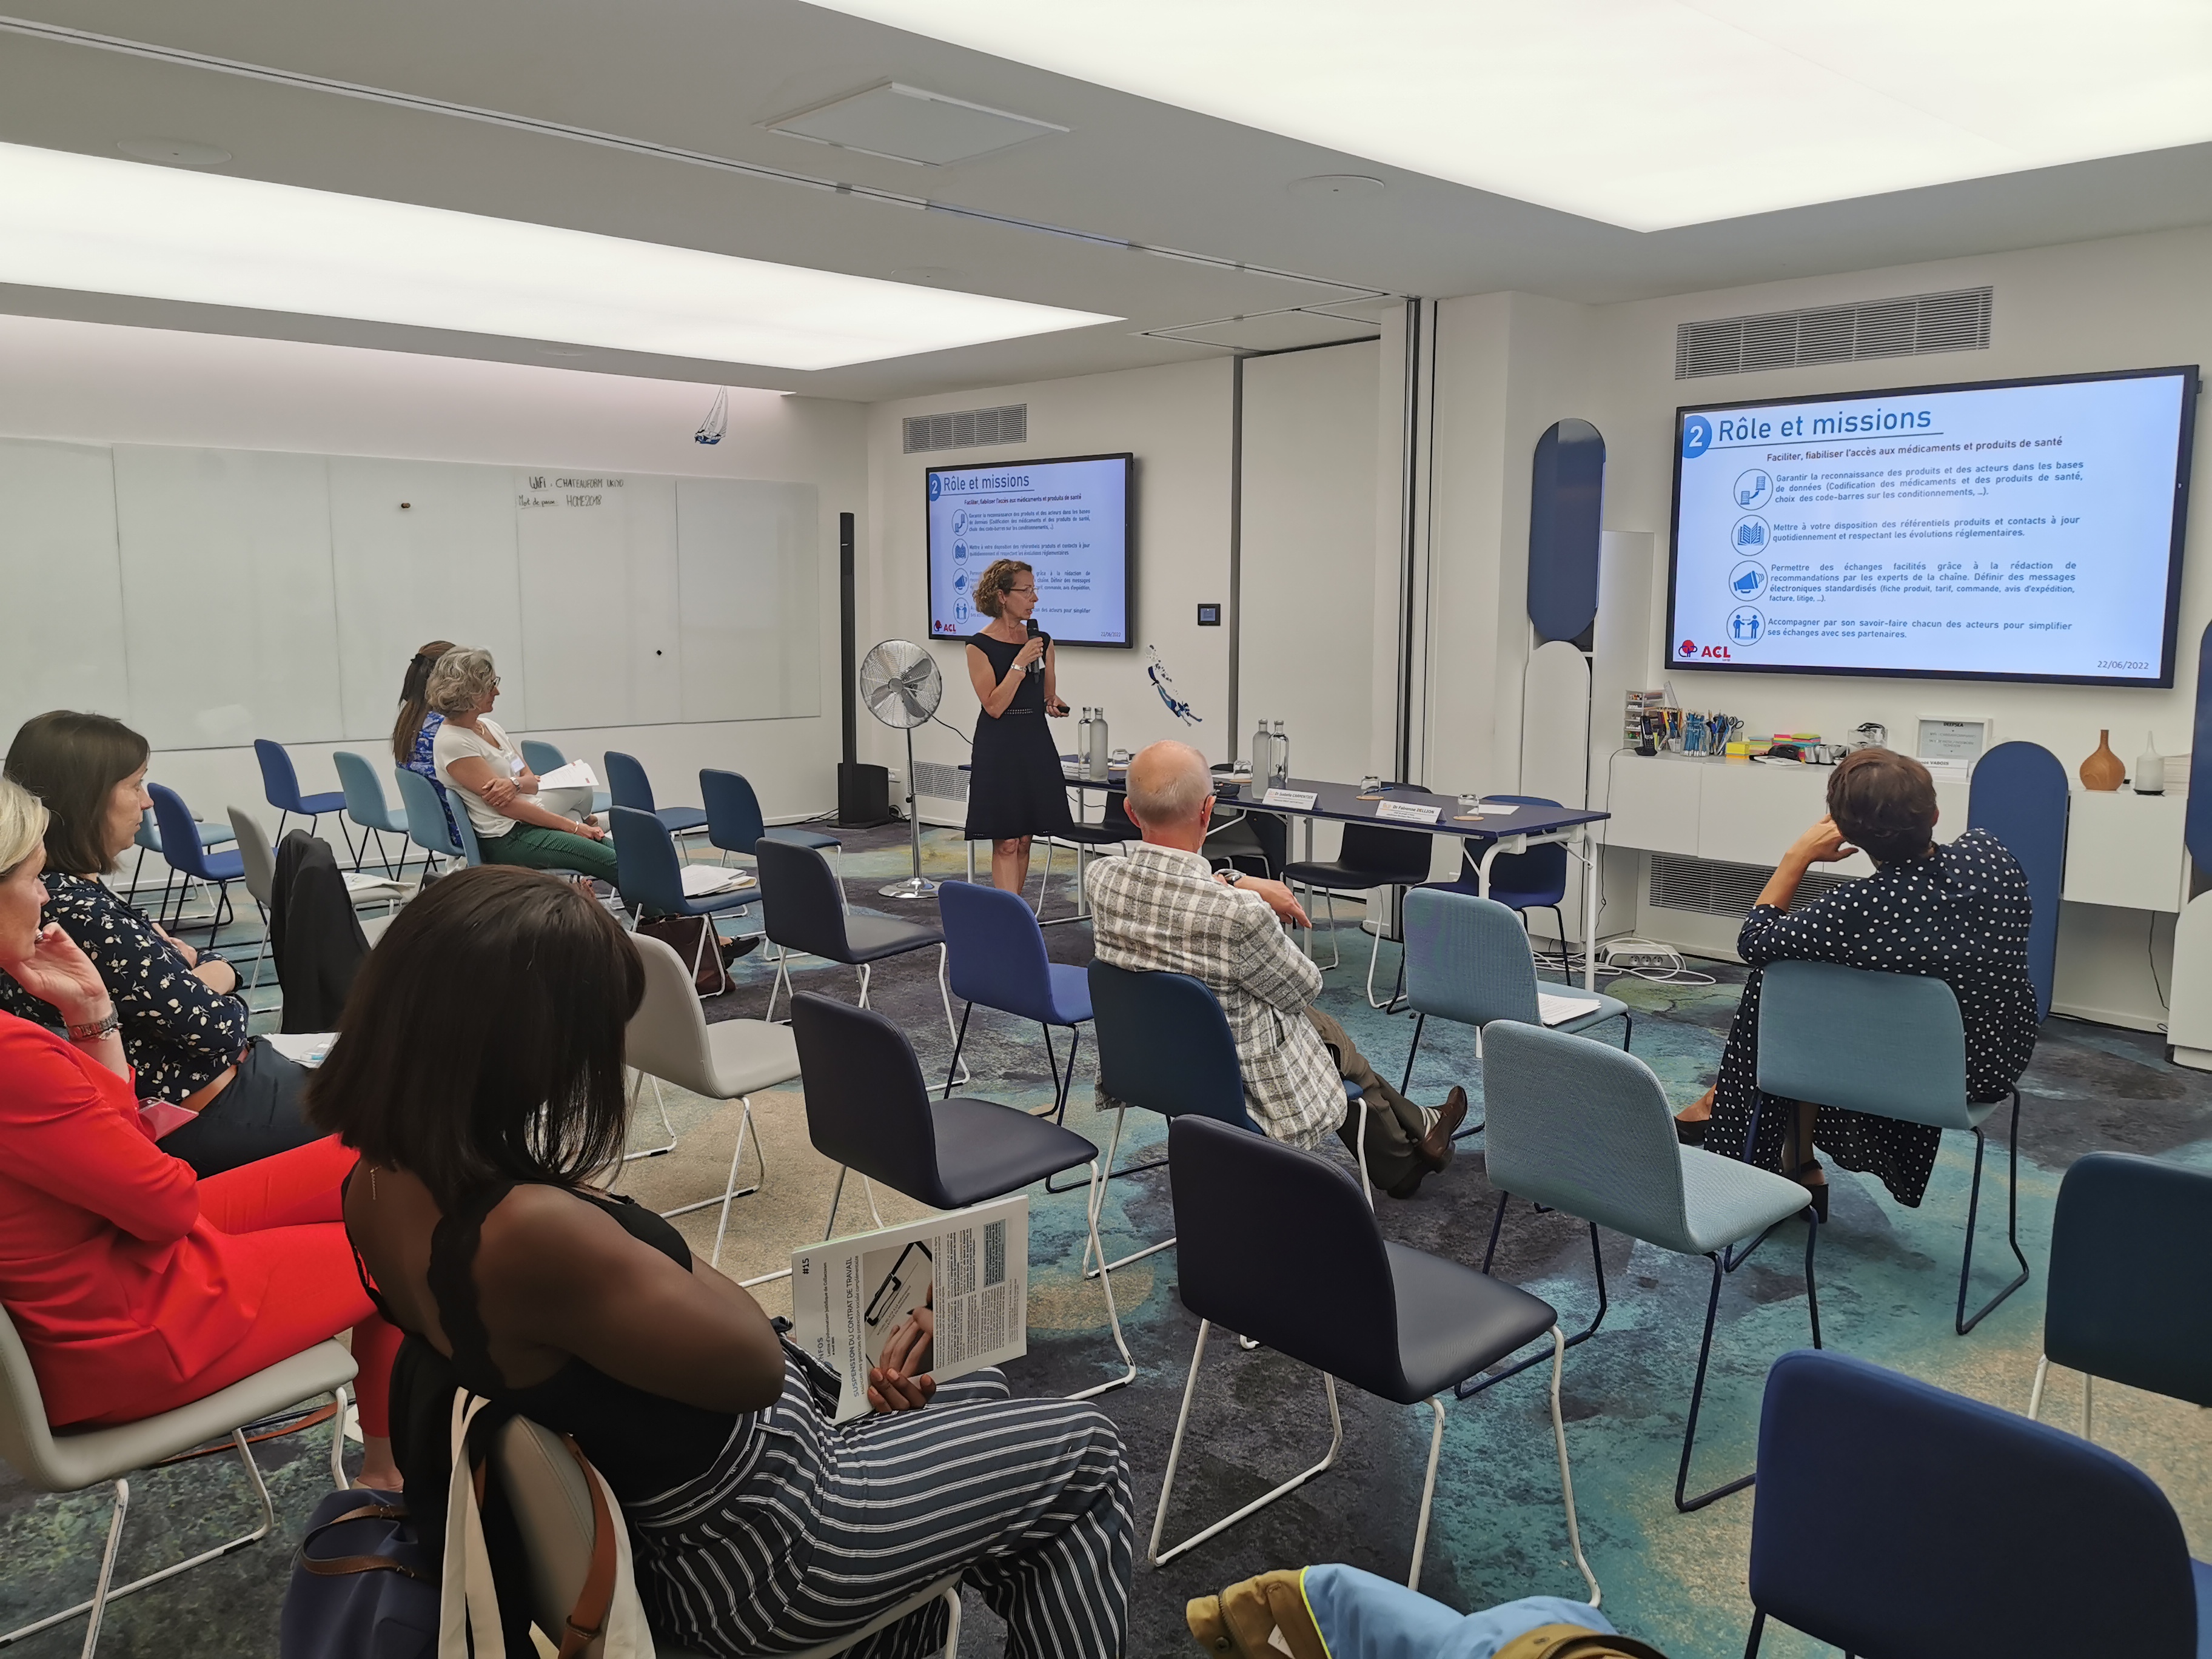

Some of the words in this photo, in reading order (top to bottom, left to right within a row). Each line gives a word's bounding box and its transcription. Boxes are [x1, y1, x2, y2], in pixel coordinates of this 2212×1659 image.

[1687, 424, 1703, 448] 2
[1719, 416, 1771, 442] Rôle
[1781, 415, 1803, 437] et
[1812, 407, 1931, 435] missions
[1805, 450, 1844, 460] fiabiliser
[1898, 443, 1961, 454] médicaments
[1963, 442, 1973, 451] et
[1976, 440, 2017, 452] produits
[2019, 438, 2032, 448] de
[2034, 435, 2063, 447] santé
[1776, 473, 1808, 482] Garantir
[1811, 472, 1818, 481] la
[1821, 471, 1884, 480] reconnaissance
[1905, 467, 1941, 478] produits
[1975, 464, 2009, 473] acteurs
[2012, 463, 2035, 471] dans
[2038, 461, 2053, 471] les
[2056, 461, 2084, 469] bases
[931, 480, 938, 494] 2
[943, 476, 965, 492] Rôle
[969, 478, 979, 489] et
[982, 475, 1030, 489] missions
[1775, 484, 1785, 493] de
[1789, 482, 1822, 492] données
[1880, 480, 1895, 488] des
[1900, 477, 1957, 487] médicaments
[1974, 475, 1991, 484] des
[1995, 474, 2033, 485] produits
[2037, 473, 2049, 481] de
[1775, 495, 1795, 503] choix
[1815, 492, 1865, 501] code-barres
[1882, 491, 1895, 499] les
[1801, 521, 1807, 531] à
[1834, 521, 1878, 531] disposition
[1900, 518, 1950, 528] référentiels
[1954, 518, 1991, 528] produits
[2007, 517, 2046, 525] contacts
[2060, 517, 2080, 526] jour
[1772, 532, 1837, 543] quotidiennement
[1848, 531, 1892, 541] respectant
[1909, 530, 1953, 538] évolutions
[1844, 562, 1883, 572] échanges
[1893, 562, 1926, 571] facilités
[1937, 563, 1962, 572] grâce
[1990, 561, 1999, 570] la
[2010, 561, 2053, 570] rédaction
[2065, 561, 2077, 569] de
[1770, 574, 1840, 582] recommandations
[1860, 573, 1873, 581] les
[1877, 574, 1909, 583] experts
[1974, 572, 2005, 581] Définir
[2008, 572, 2025, 581] des
[2028, 574, 2076, 583] messages
[1769, 584, 1822, 594] électroniques
[1825, 584, 1877, 592] standardisés
[1768, 618, 1821, 628] Accompagner
[1946, 620, 1962, 628] des
[2028, 622, 2073, 631] simplifier
[1783, 628, 1820, 638] échanges
[1701, 646, 1731, 658] ACL
[2097, 660, 2150, 669] 22/06/2022
[846, 1288, 853, 1298] DE
[848, 1335, 854, 1346] DU
[849, 1346, 859, 1397] SUSPENSION
